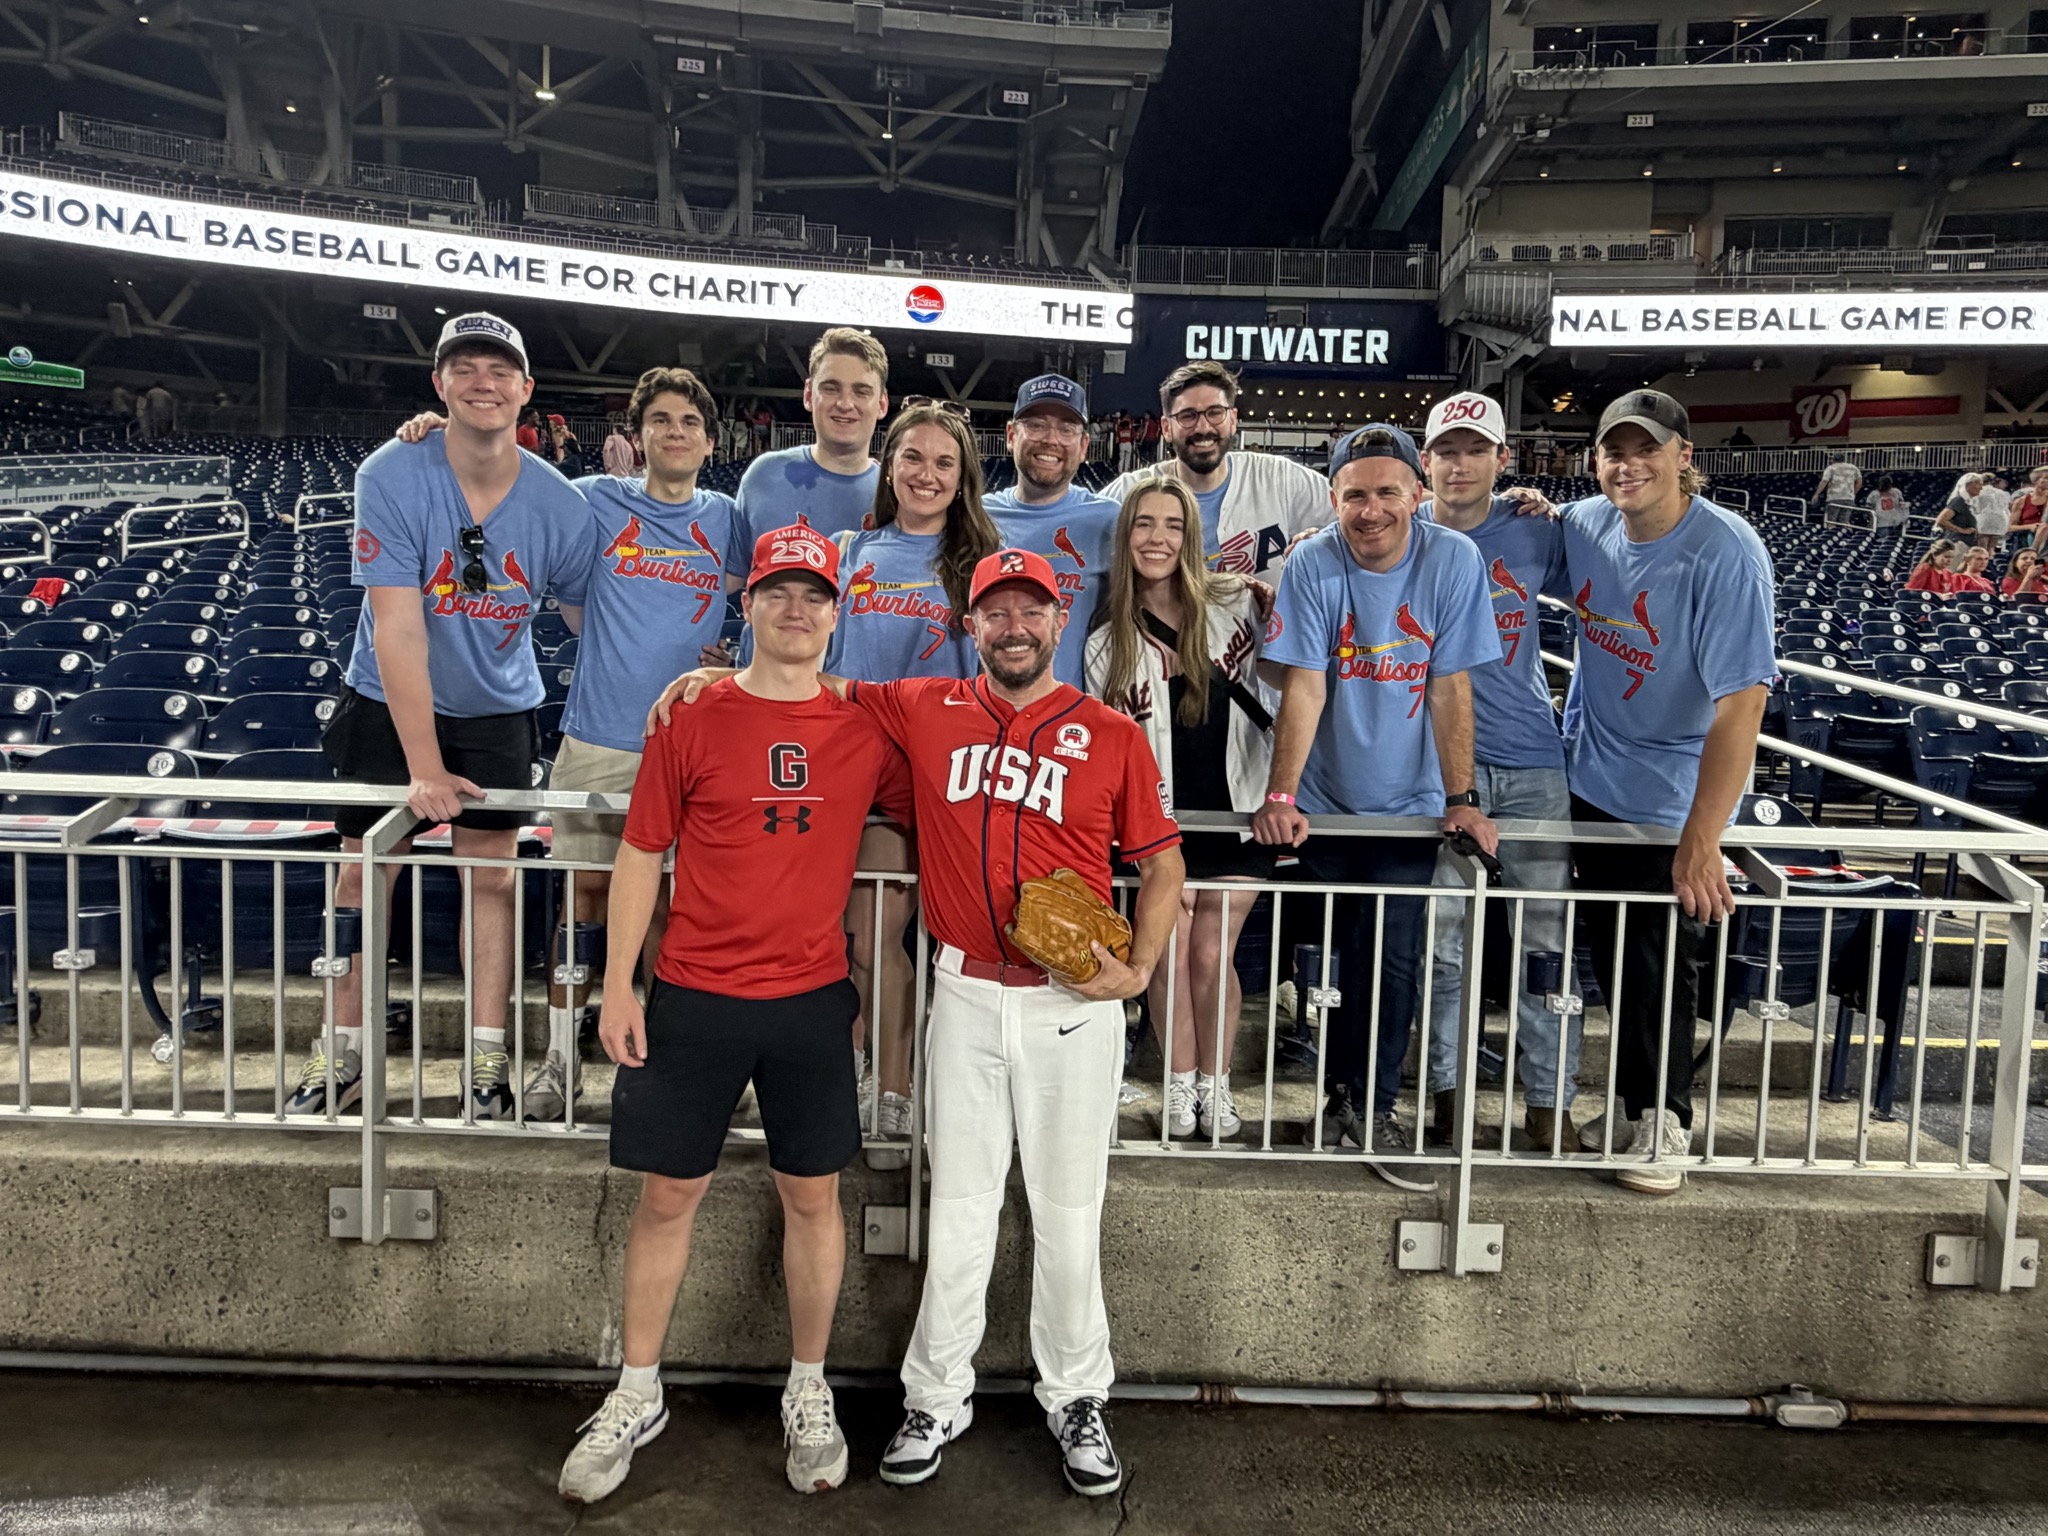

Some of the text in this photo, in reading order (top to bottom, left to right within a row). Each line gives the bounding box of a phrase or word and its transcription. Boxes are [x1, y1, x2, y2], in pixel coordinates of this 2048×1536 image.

[682, 61, 700, 71] 225
[1007, 93, 1025, 102] 223
[1632, 116, 1649, 125] 221
[204, 219, 422, 270] BASEBALL
[435, 247, 547, 283] GAME
[560, 261, 636, 294] FOR
[648, 272, 806, 307] CHARITY
[370, 306, 391, 317] 134
[1041, 301, 1104, 328] THE
[1560, 305, 2035, 333] NAL BASEBALL GAME FOR
[1186, 325, 1389, 364] CUTWATER
[932, 355, 949, 365] 133
[1030, 380, 1073, 393] SWEET
[1441, 399, 1486, 425] 250
[1795, 388, 1846, 434] W
[645, 548, 667, 556] TEAM
[773, 529, 825, 548] AMERICA
[1220, 523, 1287, 576] SA
[612, 541, 720, 592] Burlison
[770, 540, 826, 568] 250
[432, 578, 531, 620] Burlison
[878, 582, 901, 590] TEAM
[691, 592, 712, 624] 7
[849, 578, 957, 630] Burlison
[495, 622, 520, 650] 7
[918, 625, 946, 661] 7
[1503, 632, 1520, 667] 7
[1622, 668, 1644, 701] 7
[321, 705, 332, 714] 10
[1407, 684, 1425, 719] 7
[155, 760, 169, 769] 10
[768, 742, 808, 790] G
[946, 744, 1069, 826] USA
[1761, 807, 1775, 817] 19
